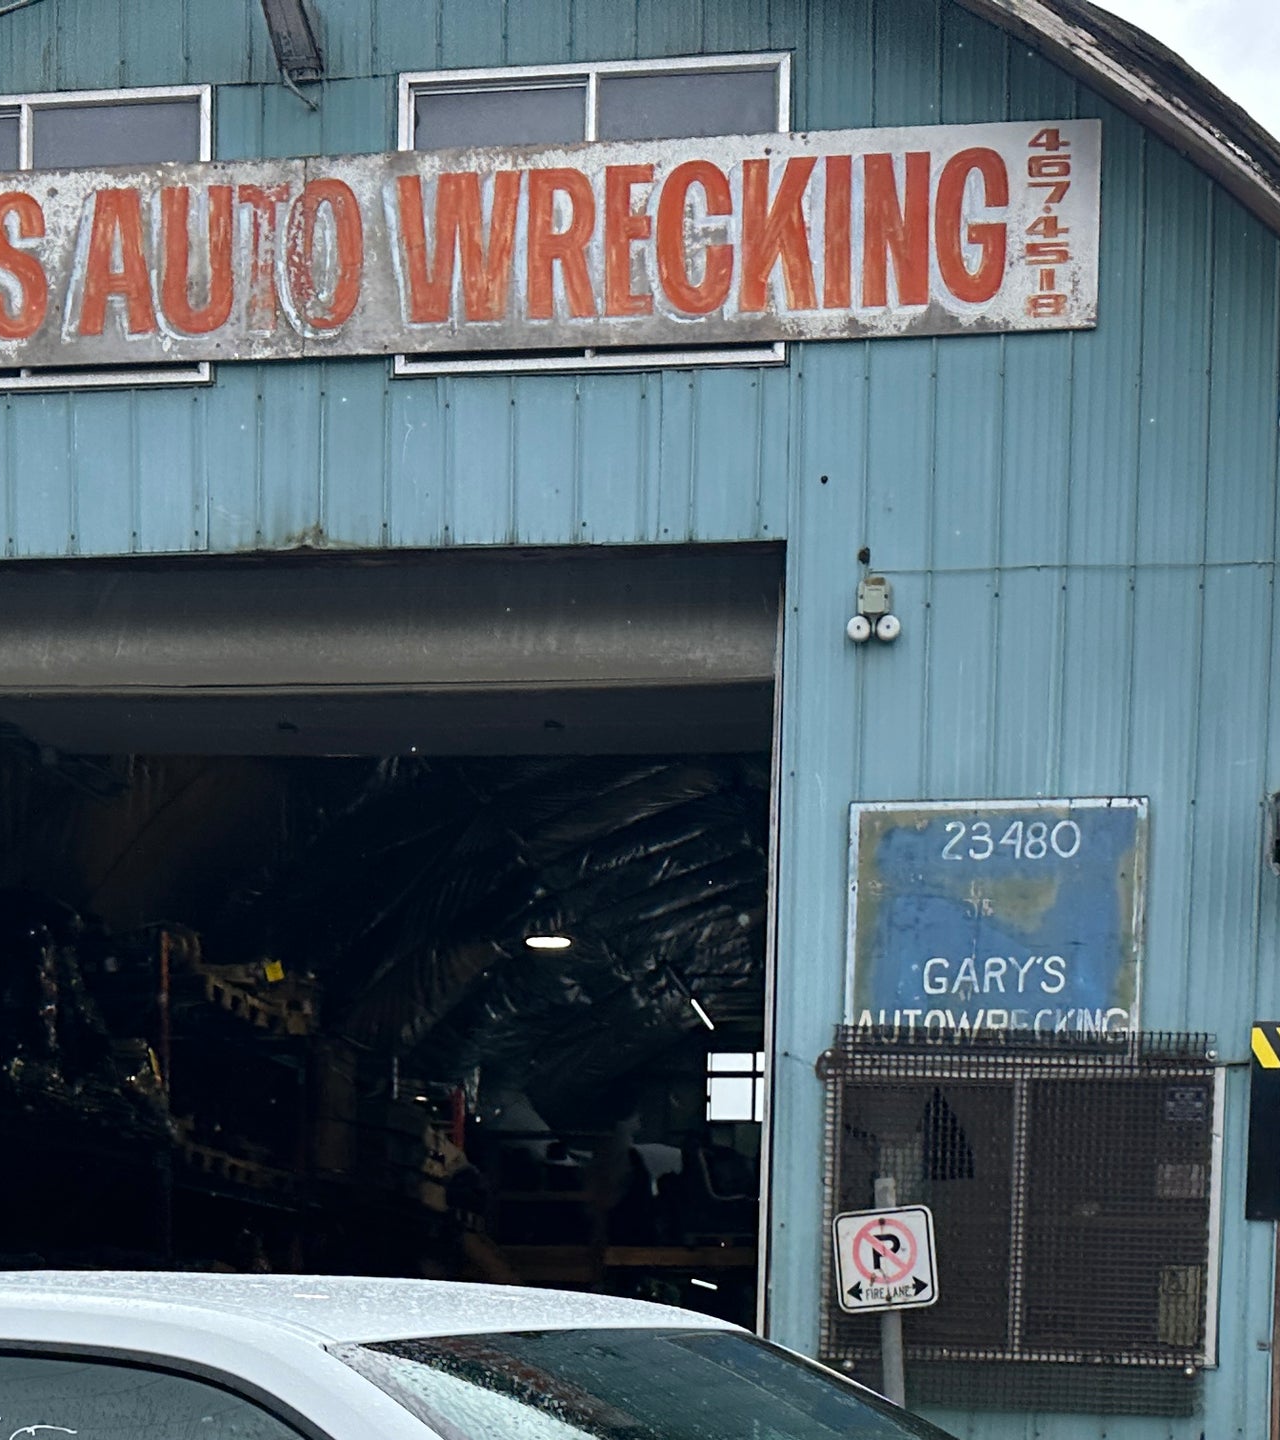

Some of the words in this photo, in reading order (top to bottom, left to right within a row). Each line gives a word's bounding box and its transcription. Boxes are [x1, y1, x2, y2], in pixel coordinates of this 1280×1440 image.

[77, 176, 365, 338] AUTO
[395, 146, 1010, 325] WRECKING
[941, 820, 1082, 861] 23480
[922, 955, 1068, 996] GARY'S
[865, 1287, 885, 1300] FIRE
[885, 1285, 911, 1298] LANE
